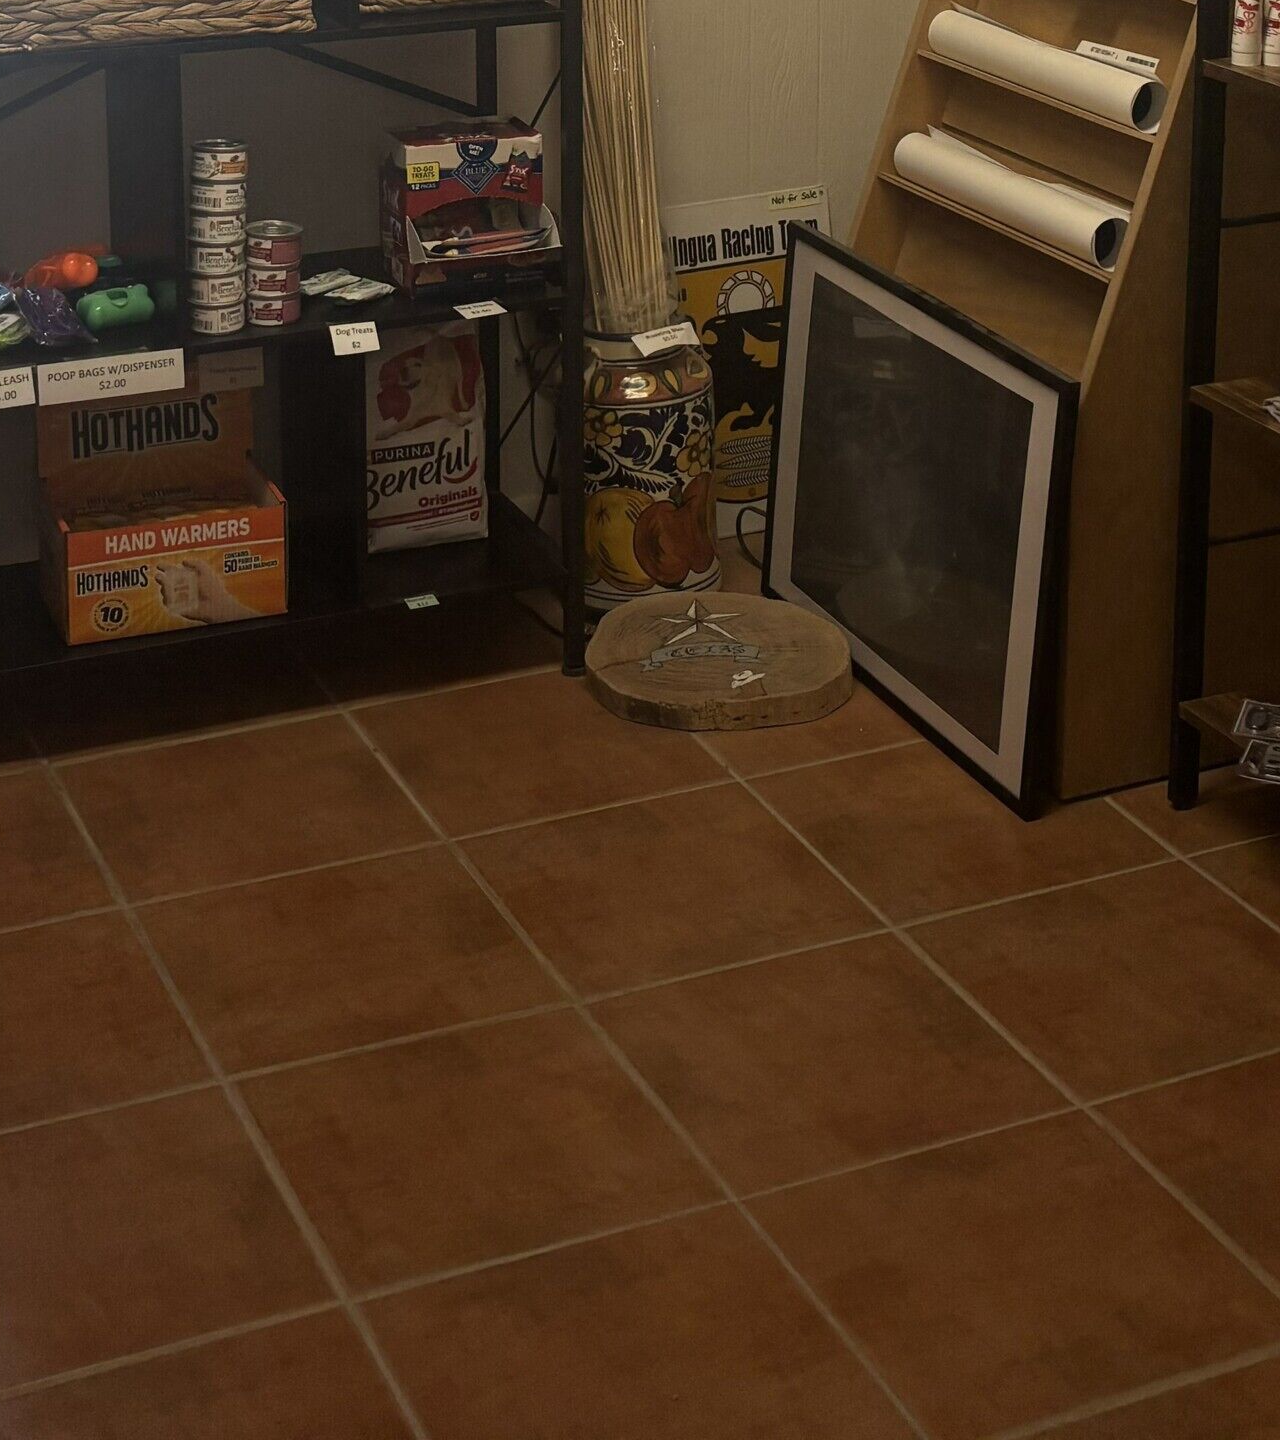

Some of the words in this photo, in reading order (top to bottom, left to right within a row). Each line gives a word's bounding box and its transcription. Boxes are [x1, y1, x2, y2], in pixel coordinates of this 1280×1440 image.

[771, 196, 785, 206] Not
[788, 193, 798, 203] for
[801, 190, 818, 200] Sale
[721, 224, 774, 260] Racing
[336, 327, 351, 336] Dog
[351, 326, 374, 335] Treats
[48, 370, 75, 383] POOP
[76, 366, 106, 380] BAGS
[106, 358, 176, 377] W/DISPENSER
[99, 378, 127, 391] $2.00
[72, 394, 220, 460] HOTHANDS
[374, 445, 433, 462] PURINA
[418, 486, 478, 509] Originals
[105, 530, 157, 556] HAND
[161, 516, 251, 547] WARMERS
[224, 559, 238, 573] 50
[76, 565, 149, 596] HOTHANDS
[100, 606, 123, 625] 10
